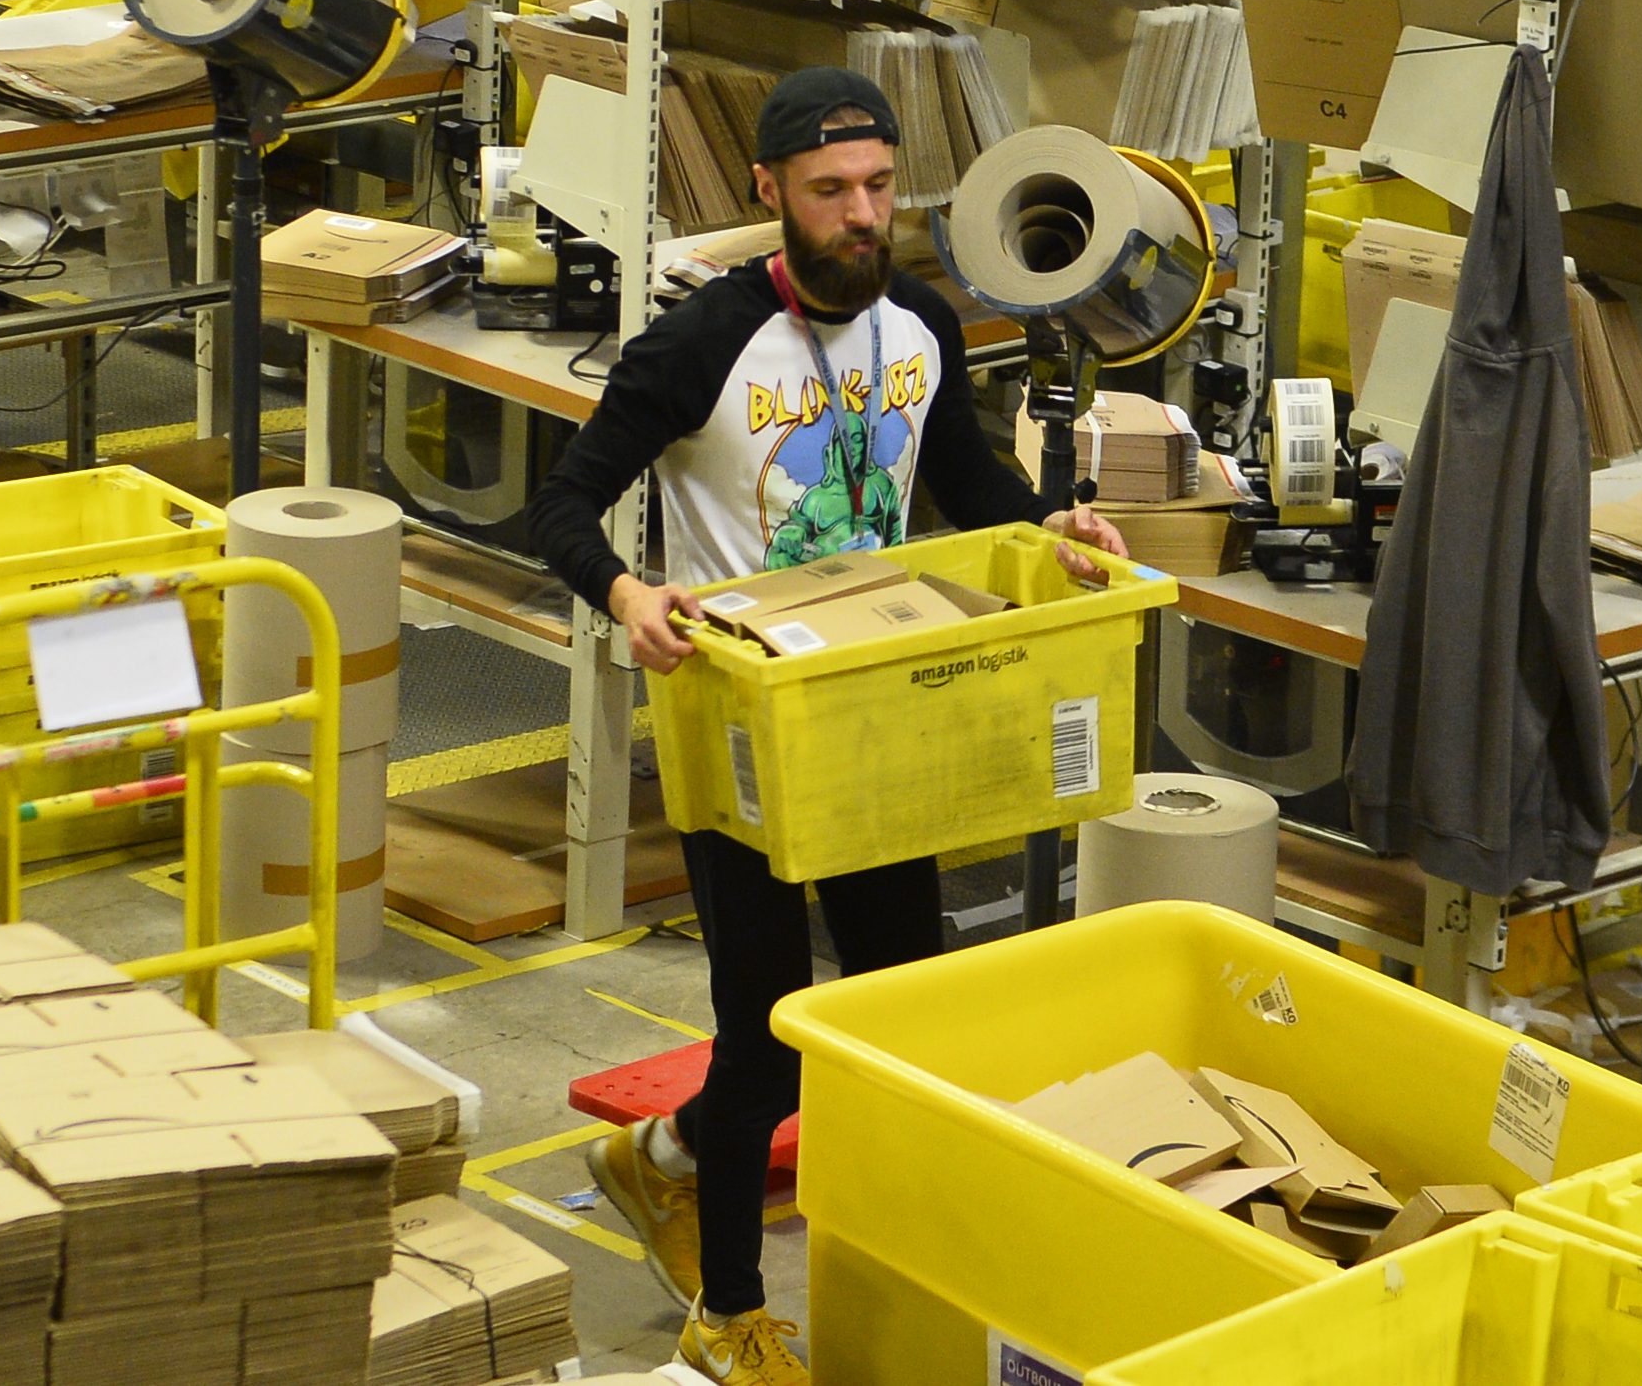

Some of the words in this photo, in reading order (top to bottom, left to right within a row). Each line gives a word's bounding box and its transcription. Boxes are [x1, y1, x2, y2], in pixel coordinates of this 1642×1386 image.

[1319, 99, 1348, 120] C4
[871, 324, 882, 388] INSTRUCTOR
[910, 659, 975, 685] amazon
[977, 646, 1029, 673] logistik
[1557, 1076, 1570, 1092] KO
